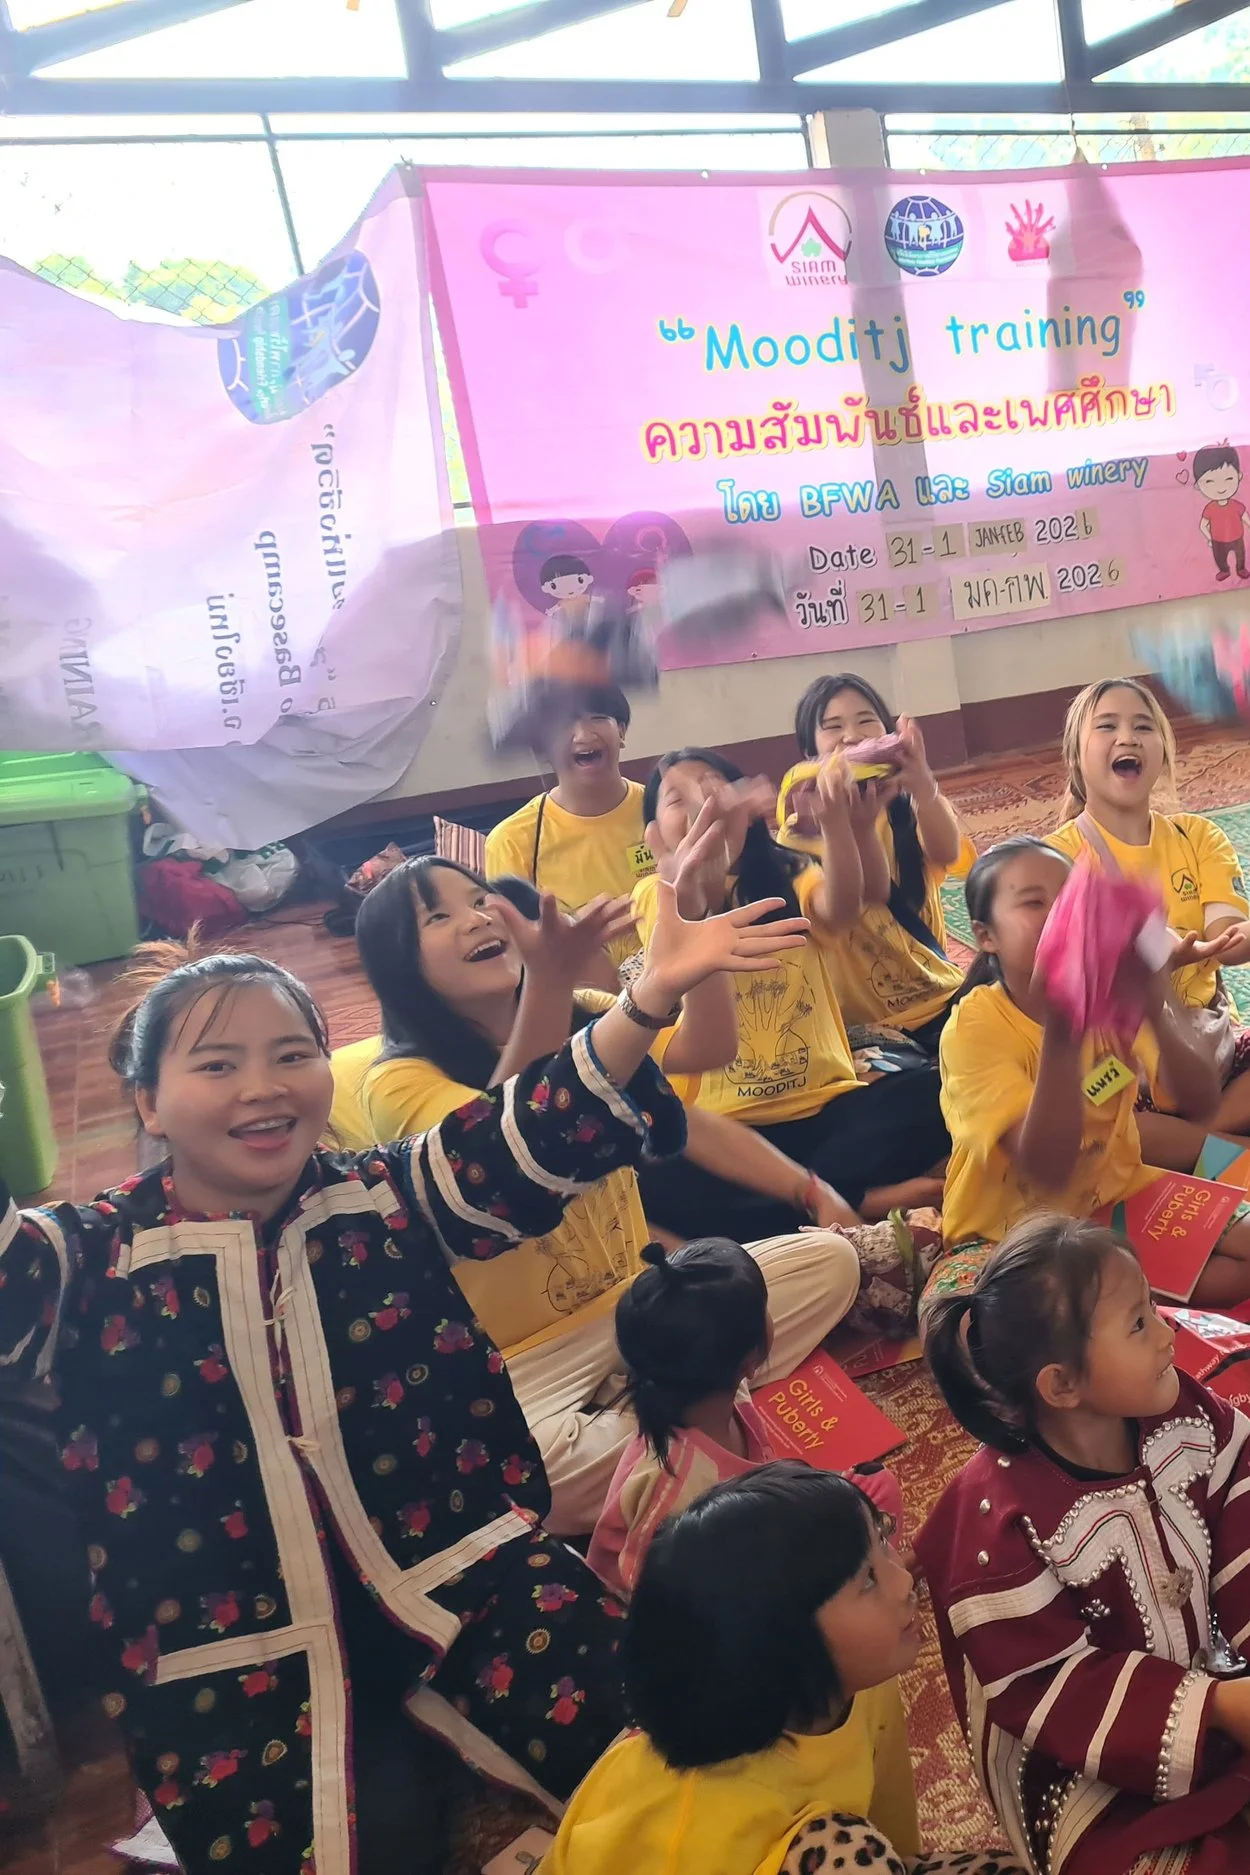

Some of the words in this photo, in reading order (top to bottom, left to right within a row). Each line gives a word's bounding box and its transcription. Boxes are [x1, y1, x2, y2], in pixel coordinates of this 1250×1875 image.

[791, 260, 836, 273] SIAM
[644, 378, 1174, 460] ความสัมพันธ์และเพศศึกษา
[717, 480, 781, 523] โดย
[801, 480, 898, 518] BFWA
[916, 475, 969, 506] และ
[987, 466, 1052, 498] Siam
[1067, 457, 1149, 489] winery
[809, 546, 876, 571] Date
[795, 580, 849, 628] วันที่
[737, 1076, 807, 1097] MOODITJ
[1151, 1184, 1196, 1241] Puberty
[1186, 1189, 1212, 1221] Girls
[1170, 1226, 1188, 1239] &
[768, 1391, 825, 1450] Puberty
[789, 1379, 824, 1417] Girls
[820, 1416, 839, 1432] &
